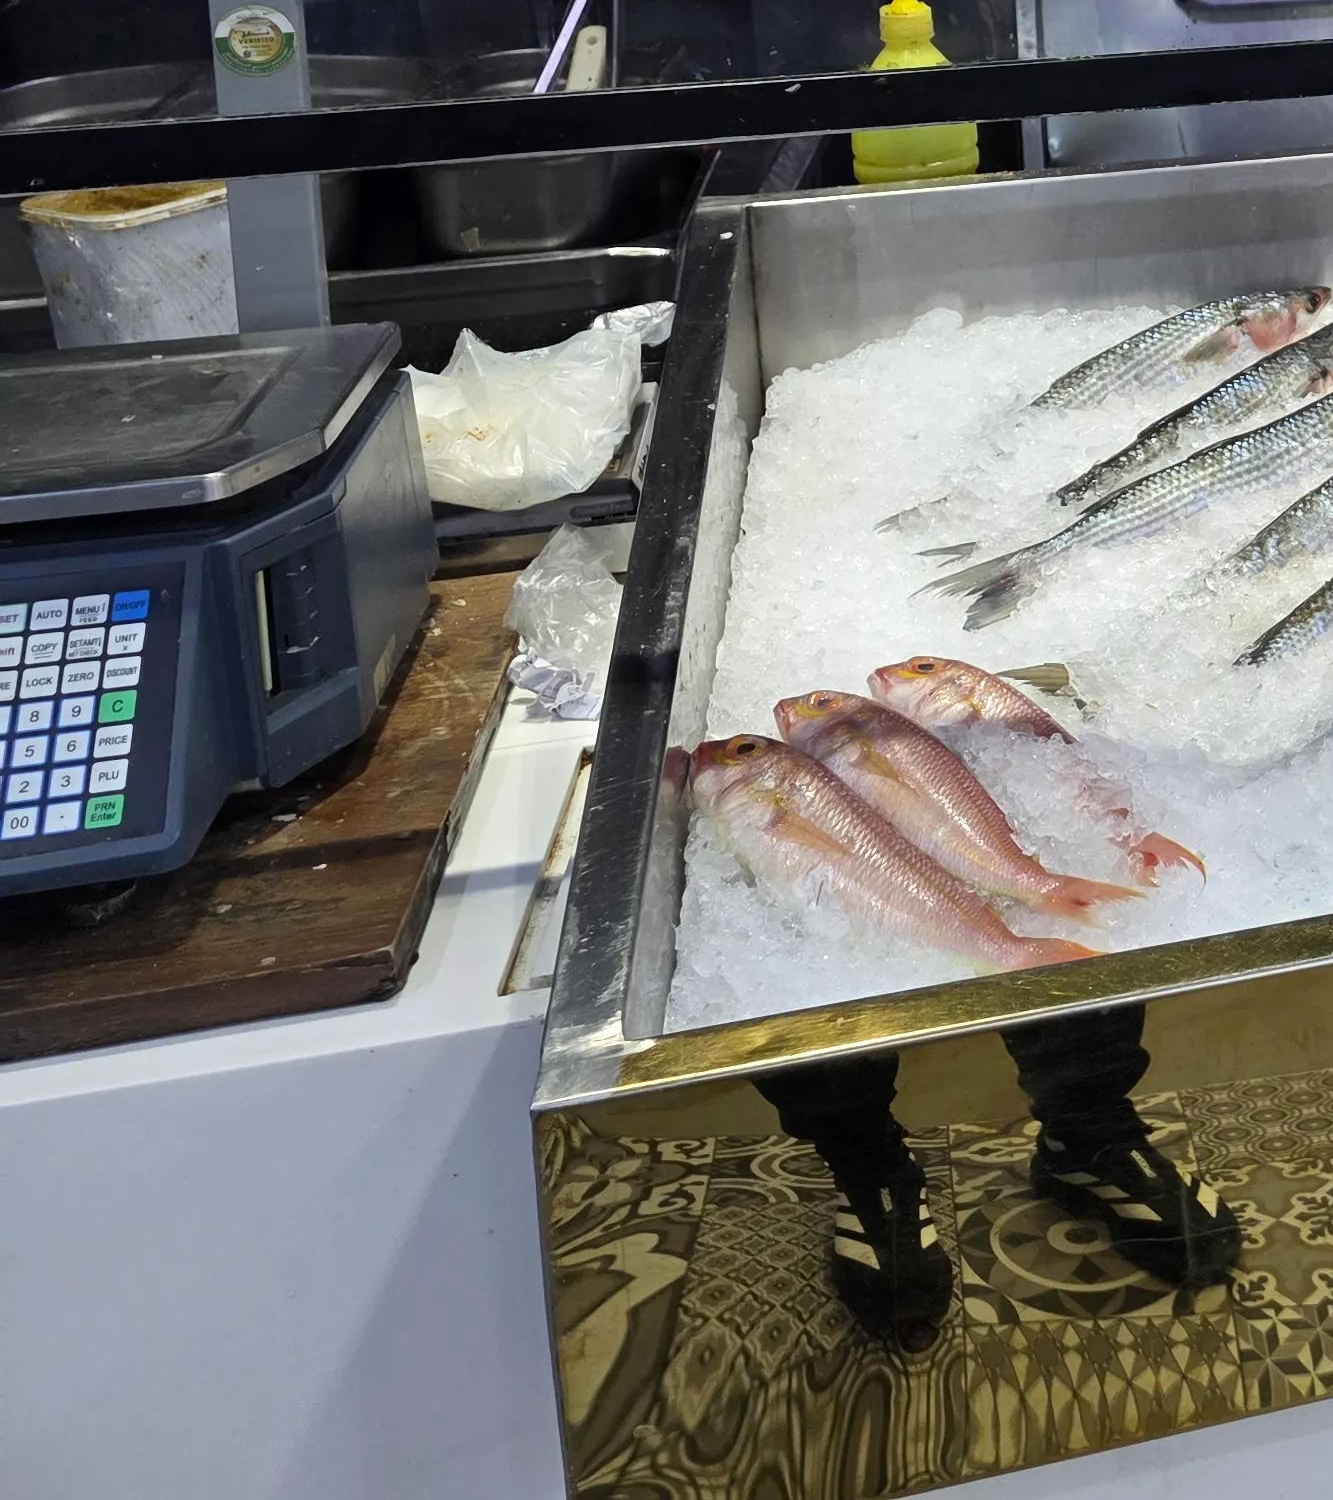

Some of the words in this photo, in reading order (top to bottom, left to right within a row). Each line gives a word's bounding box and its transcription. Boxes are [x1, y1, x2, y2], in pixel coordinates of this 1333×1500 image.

[75, 605, 100, 615] MENU
[115, 600, 146, 612] ON/OFF
[36, 609, 62, 621] AUTO
[69, 637, 98, 649] SETAMT
[115, 633, 138, 644] UNIT
[31, 641, 58, 653] COPY
[67, 671, 95, 683] ZERO
[106, 666, 137, 678] DISCOUNT
[26, 676, 53, 688] LOCK
[71, 705, 82, 718] 9
[112, 699, 124, 713] C
[29, 710, 40, 723] 8
[66, 740, 77, 753] 6
[98, 735, 128, 747] PRICE
[24, 745, 35, 758] 5
[60, 775, 71, 788] 3
[98, 770, 119, 782] PLU
[18, 781, 30, 794] 2
[94, 801, 116, 812] PRN
[10, 815, 29, 830] 00
[90, 811, 117, 823] Enter
